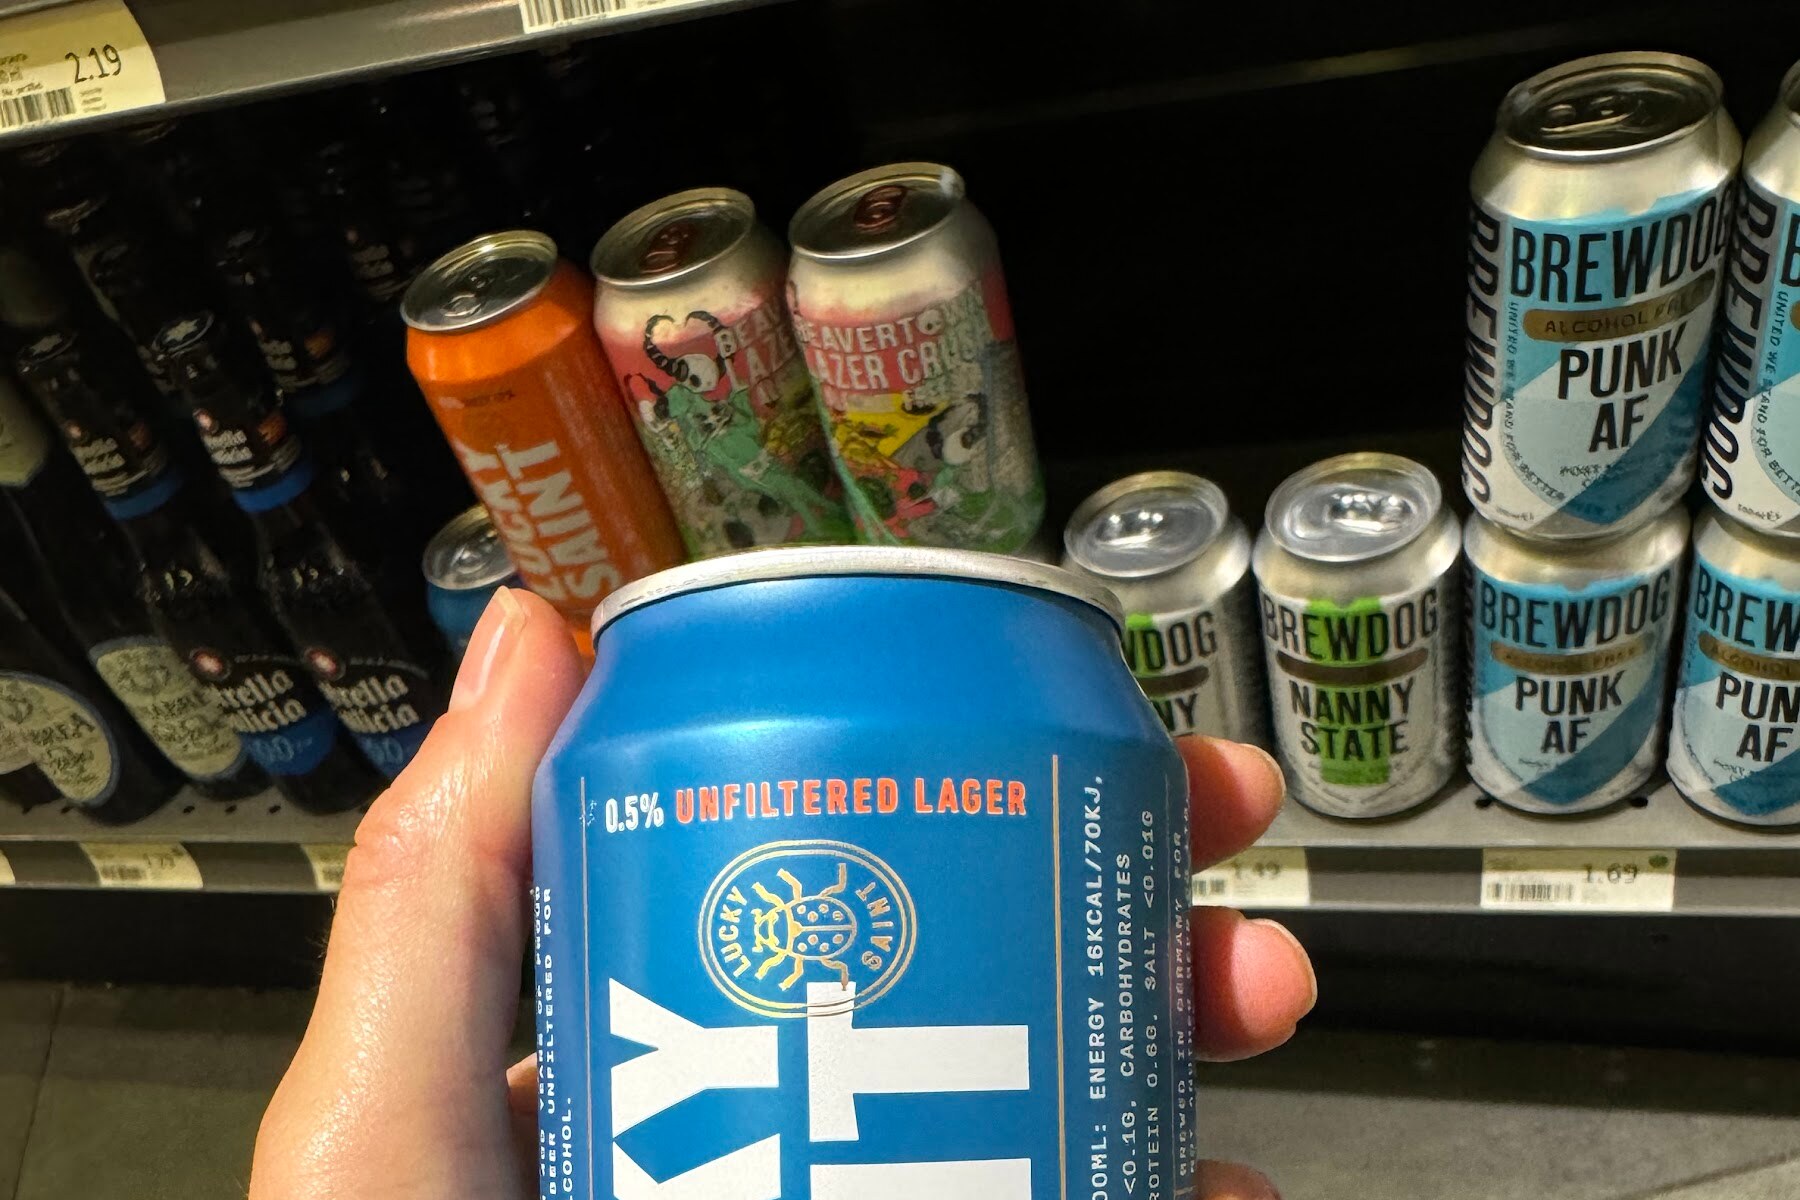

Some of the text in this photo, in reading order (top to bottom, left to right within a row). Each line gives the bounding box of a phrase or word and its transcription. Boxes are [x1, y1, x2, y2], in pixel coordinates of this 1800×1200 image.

[64, 44, 122, 84] 2.19
[1558, 321, 1688, 400] PUNK
[1588, 394, 1650, 454] AF
[494, 440, 623, 599] SAINT
[1262, 587, 1439, 662] BREWDOG
[1480, 568, 1672, 650] BREWDOG
[1288, 676, 1415, 725] NANNY
[1515, 669, 1628, 717] PUNK
[1300, 719, 1410, 762] STATE
[1540, 717, 1592, 755] AF
[1736, 723, 1794, 764] AF
[605, 777, 1028, 834] 0.5% UNFILTERED LAGER
[1084, 775, 1104, 977] 16KCAL/70KJ,
[1141, 810, 1155, 909] <0.01G
[1173, 831, 1182, 880] FOR
[543, 888, 552, 936] FOR
[715, 886, 749, 978] LUCKY
[854, 881, 893, 971] SAINT
[1116, 853, 1135, 1077] CARBOHYDRATES
[1143, 927, 1157, 991] SALT
[1174, 898, 1184, 1013] GERMANY
[544, 954, 556, 1115] UNFILTERED
[1088, 997, 1106, 1100] ENERGY
[1176, 1030, 1185, 1061] IN
[548, 1132, 558, 1195] BEER
[1121, 1100, 1137, 1195] <0.1G,
